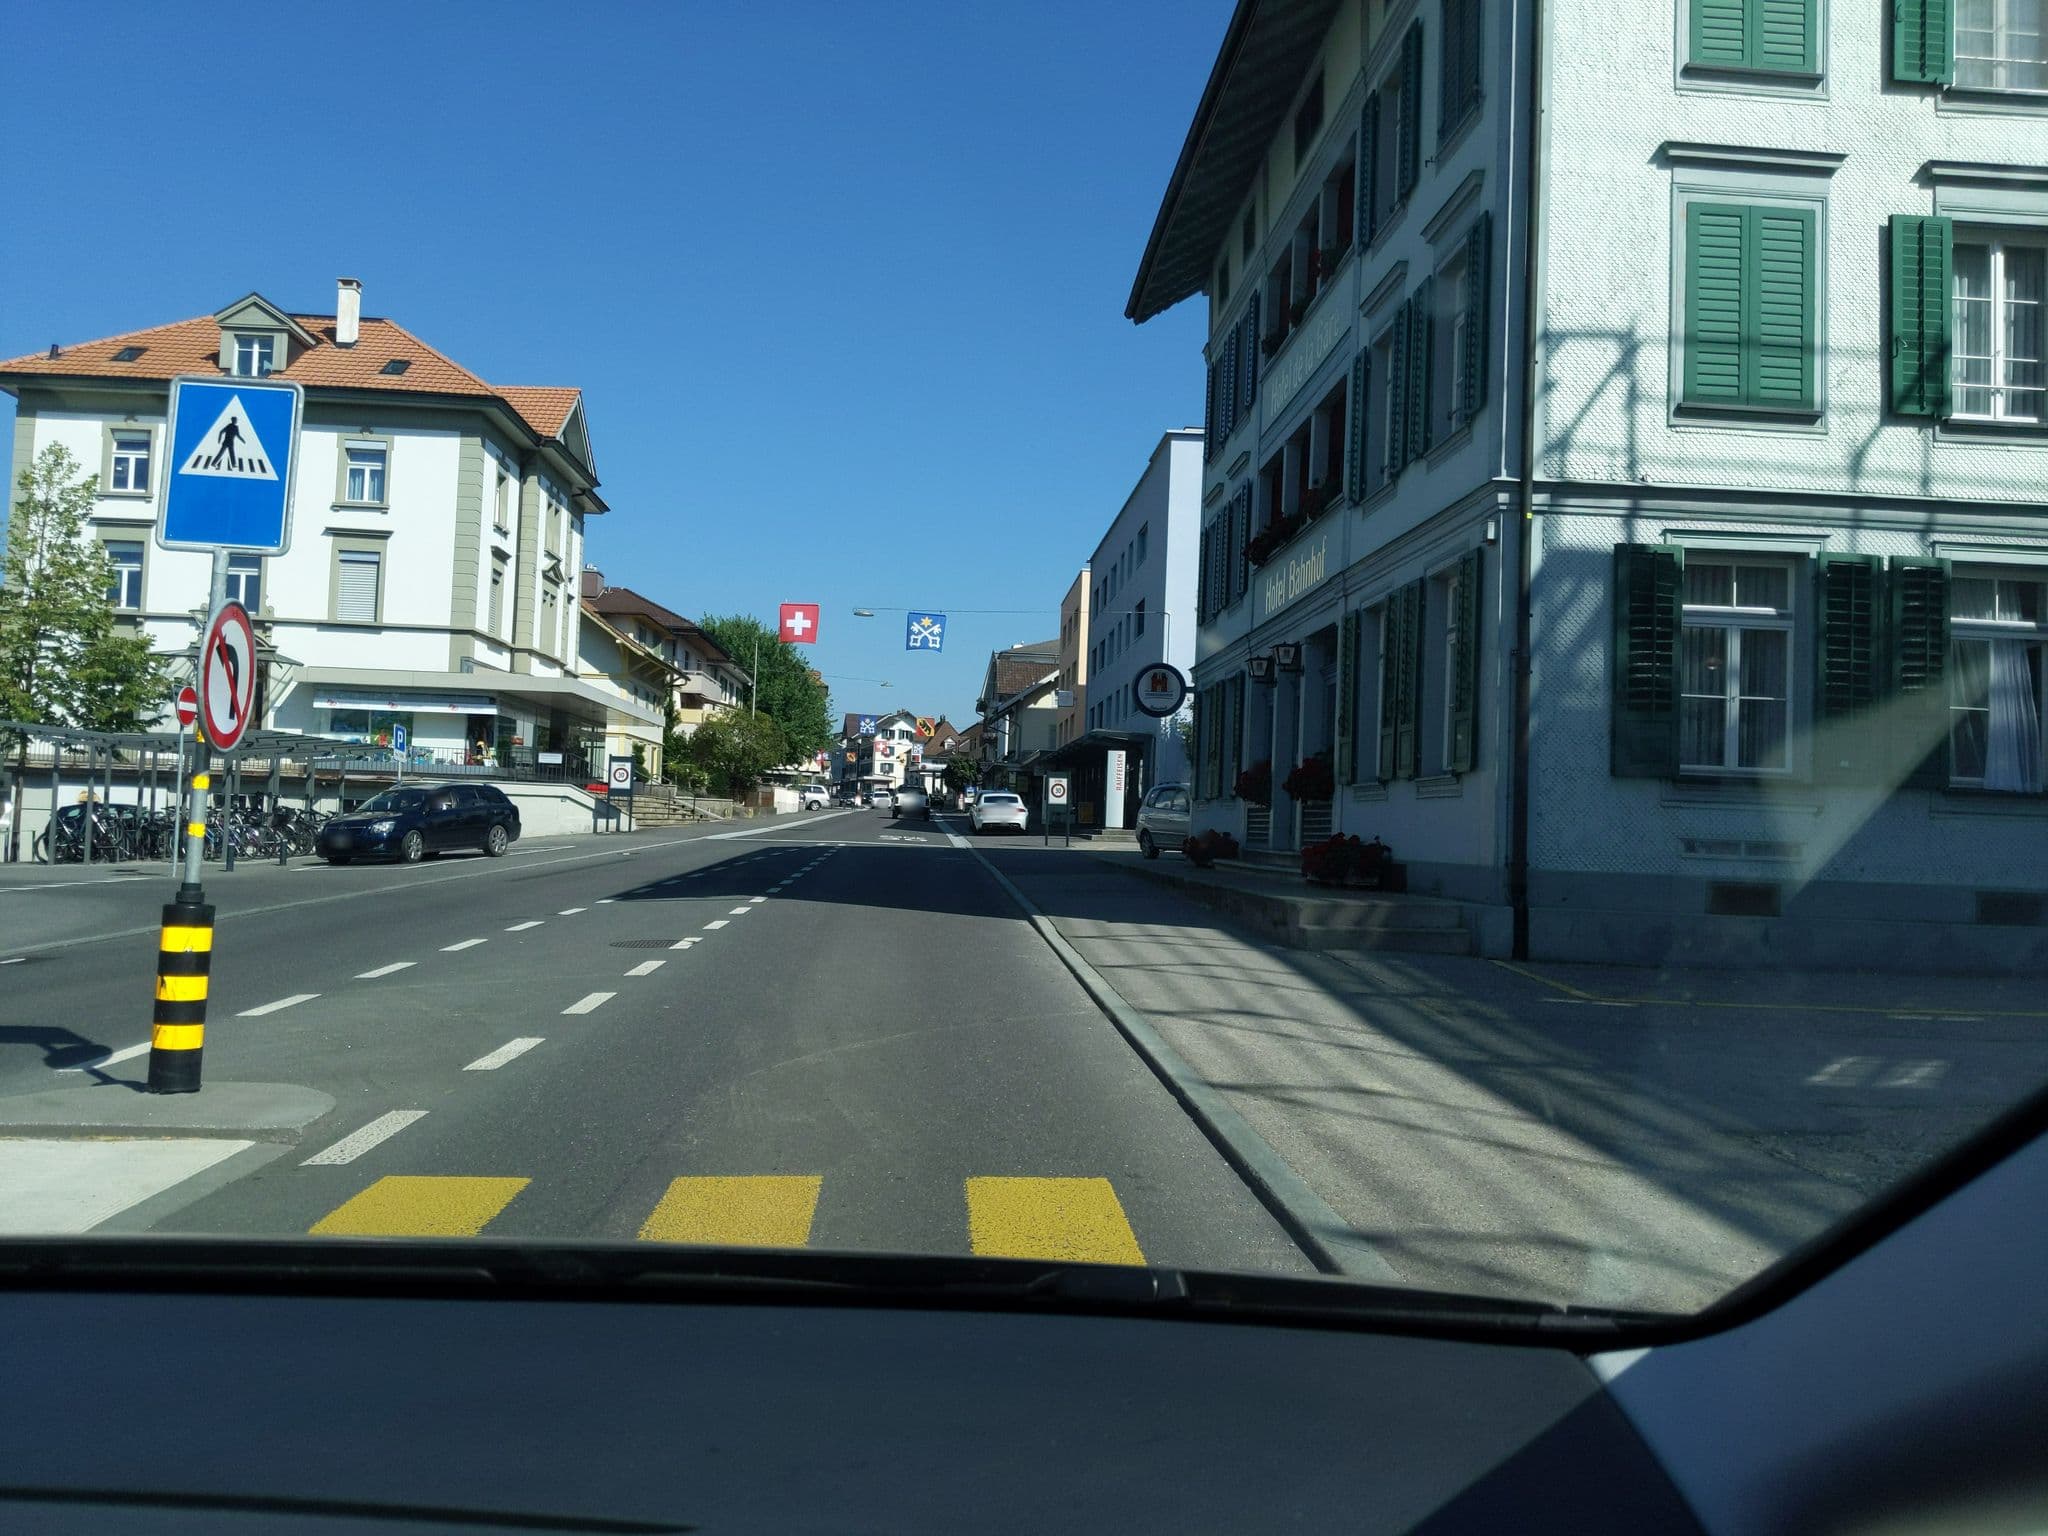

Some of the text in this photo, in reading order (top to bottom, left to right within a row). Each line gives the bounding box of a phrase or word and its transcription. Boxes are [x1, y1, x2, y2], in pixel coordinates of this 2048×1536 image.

[1265, 535, 1327, 615] Hotel Bahnhof
[397, 729, 404, 749] P
[1115, 753, 1124, 792] RAIFFEISEN
